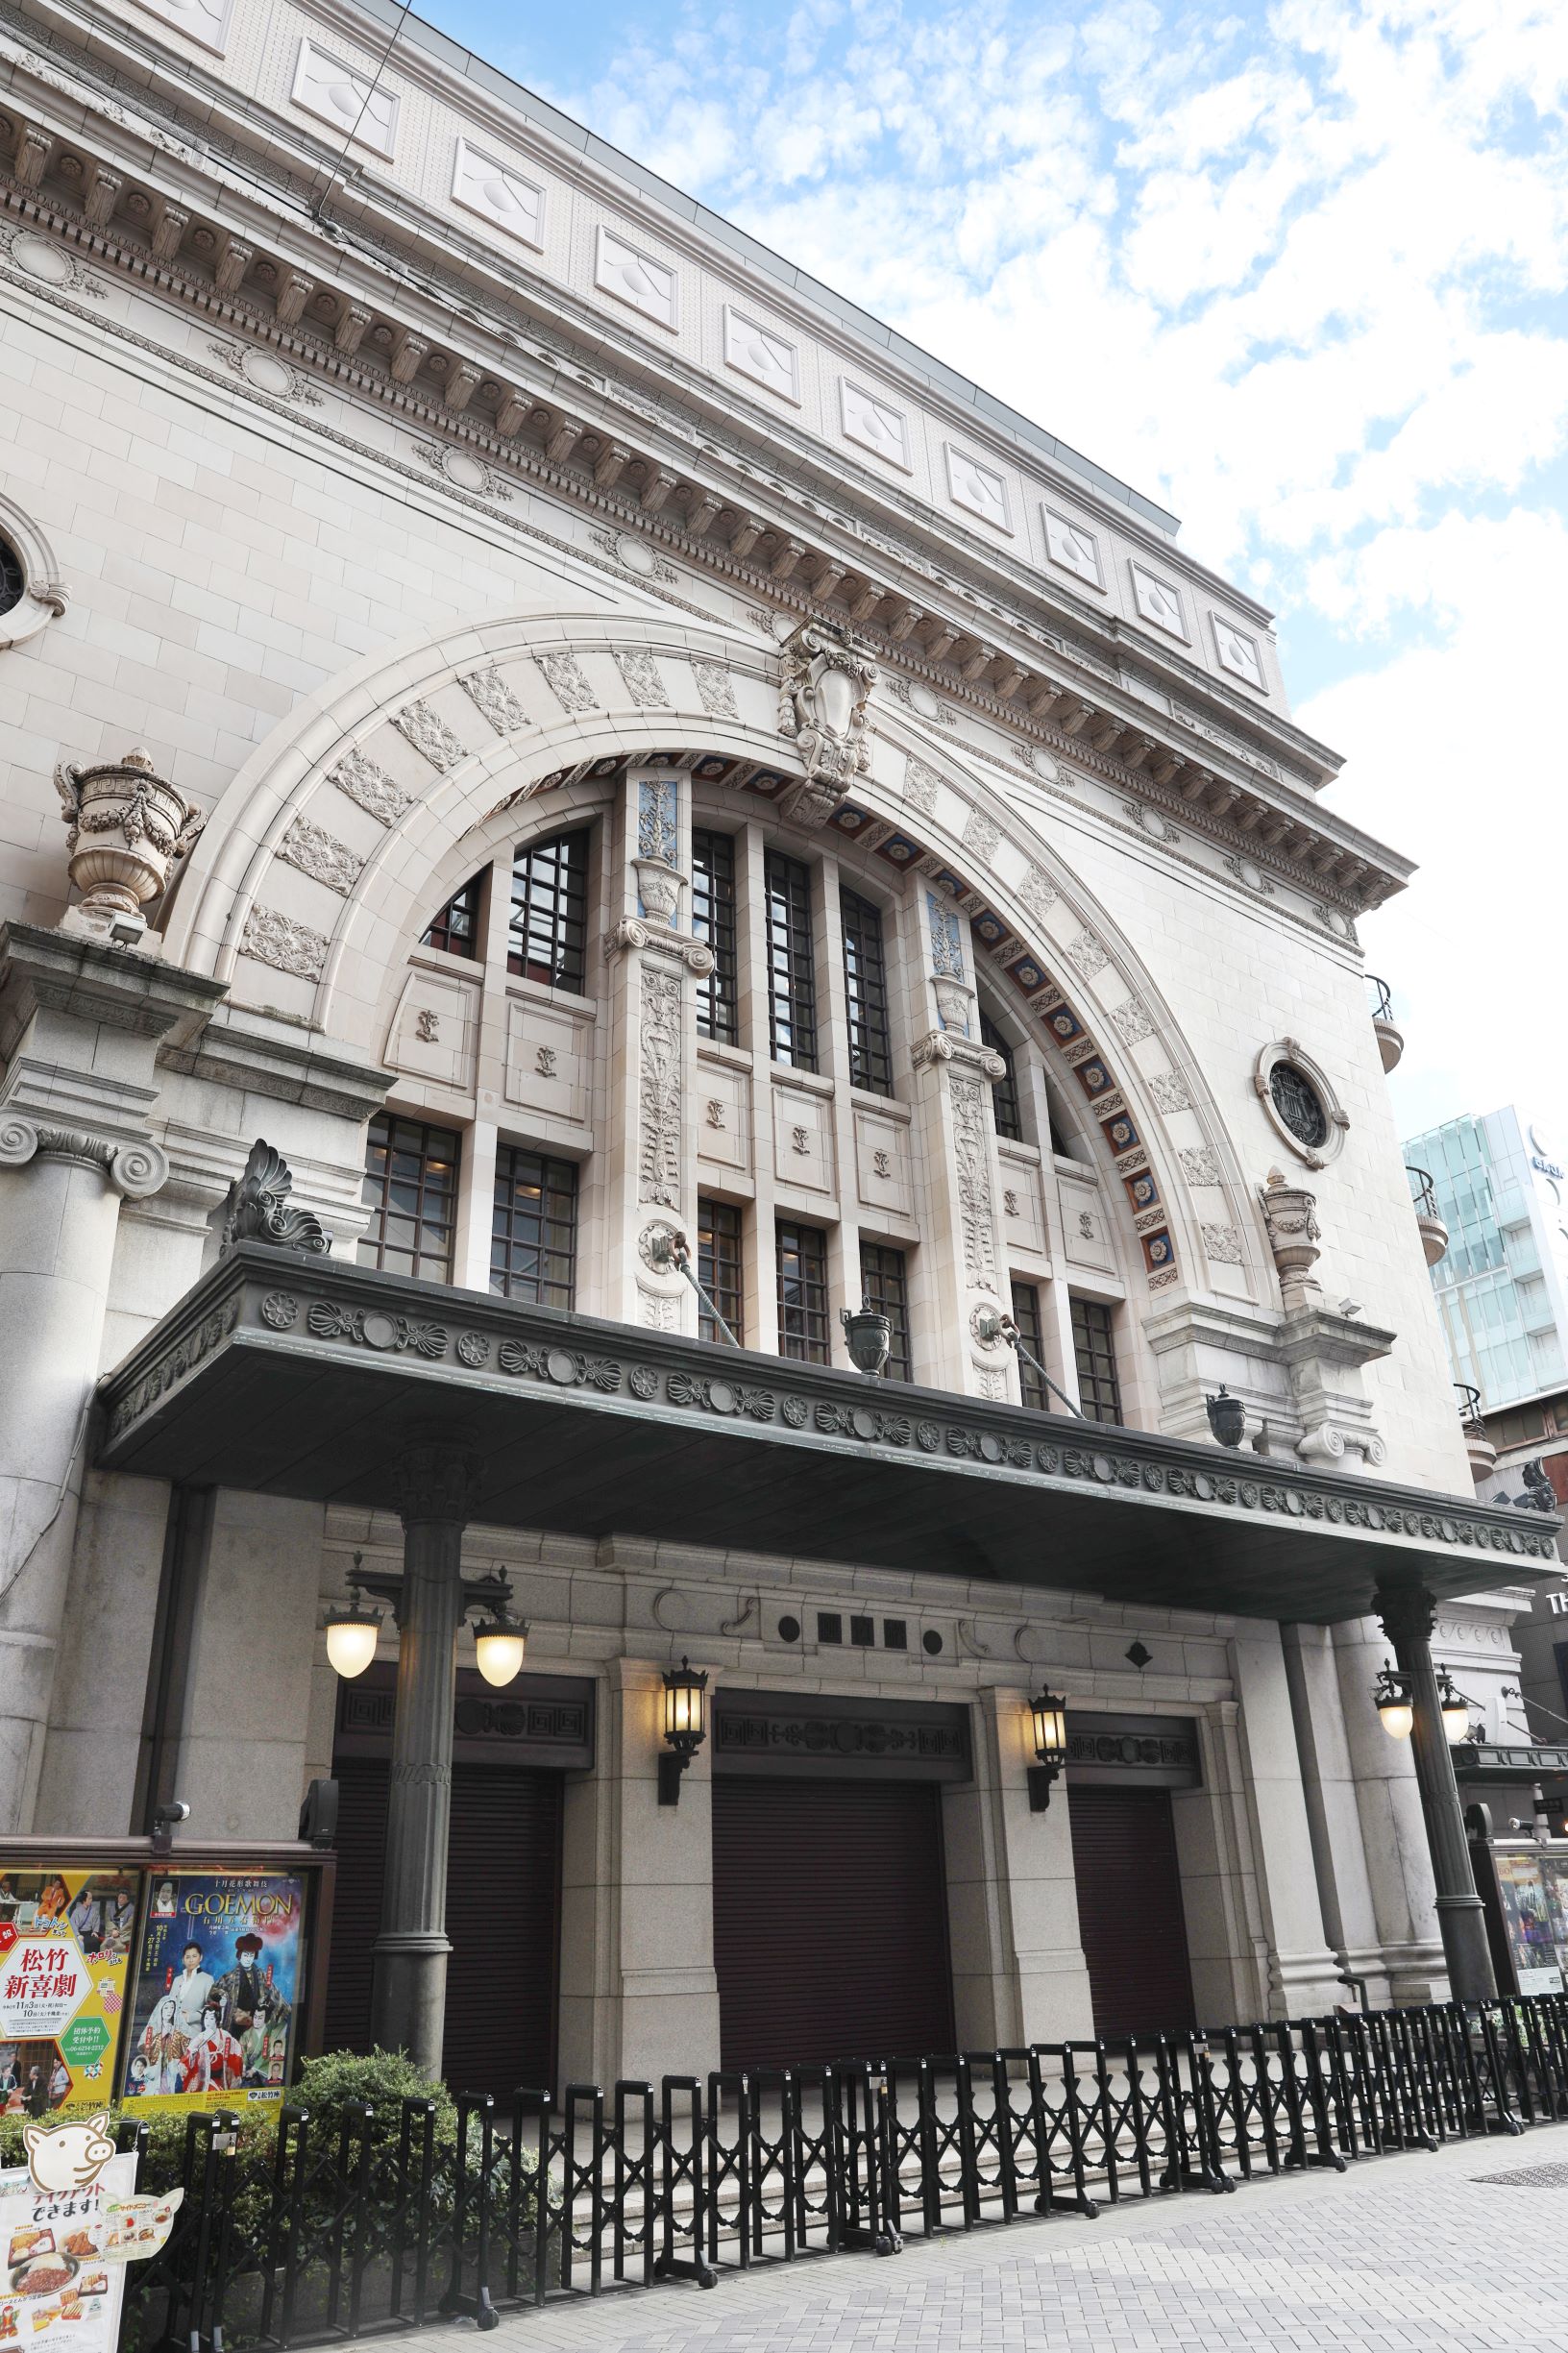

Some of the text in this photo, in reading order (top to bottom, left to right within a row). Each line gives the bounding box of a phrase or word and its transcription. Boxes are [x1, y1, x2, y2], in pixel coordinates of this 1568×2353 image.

[214, 1879, 267, 1888] 十月花形歌舞伎
[184, 1893, 292, 1915] GOEMON
[19, 1948, 69, 1973] 松竹
[3, 1973, 78, 1999] 新喜劇
[73, 2026, 101, 2035] 団体予約
